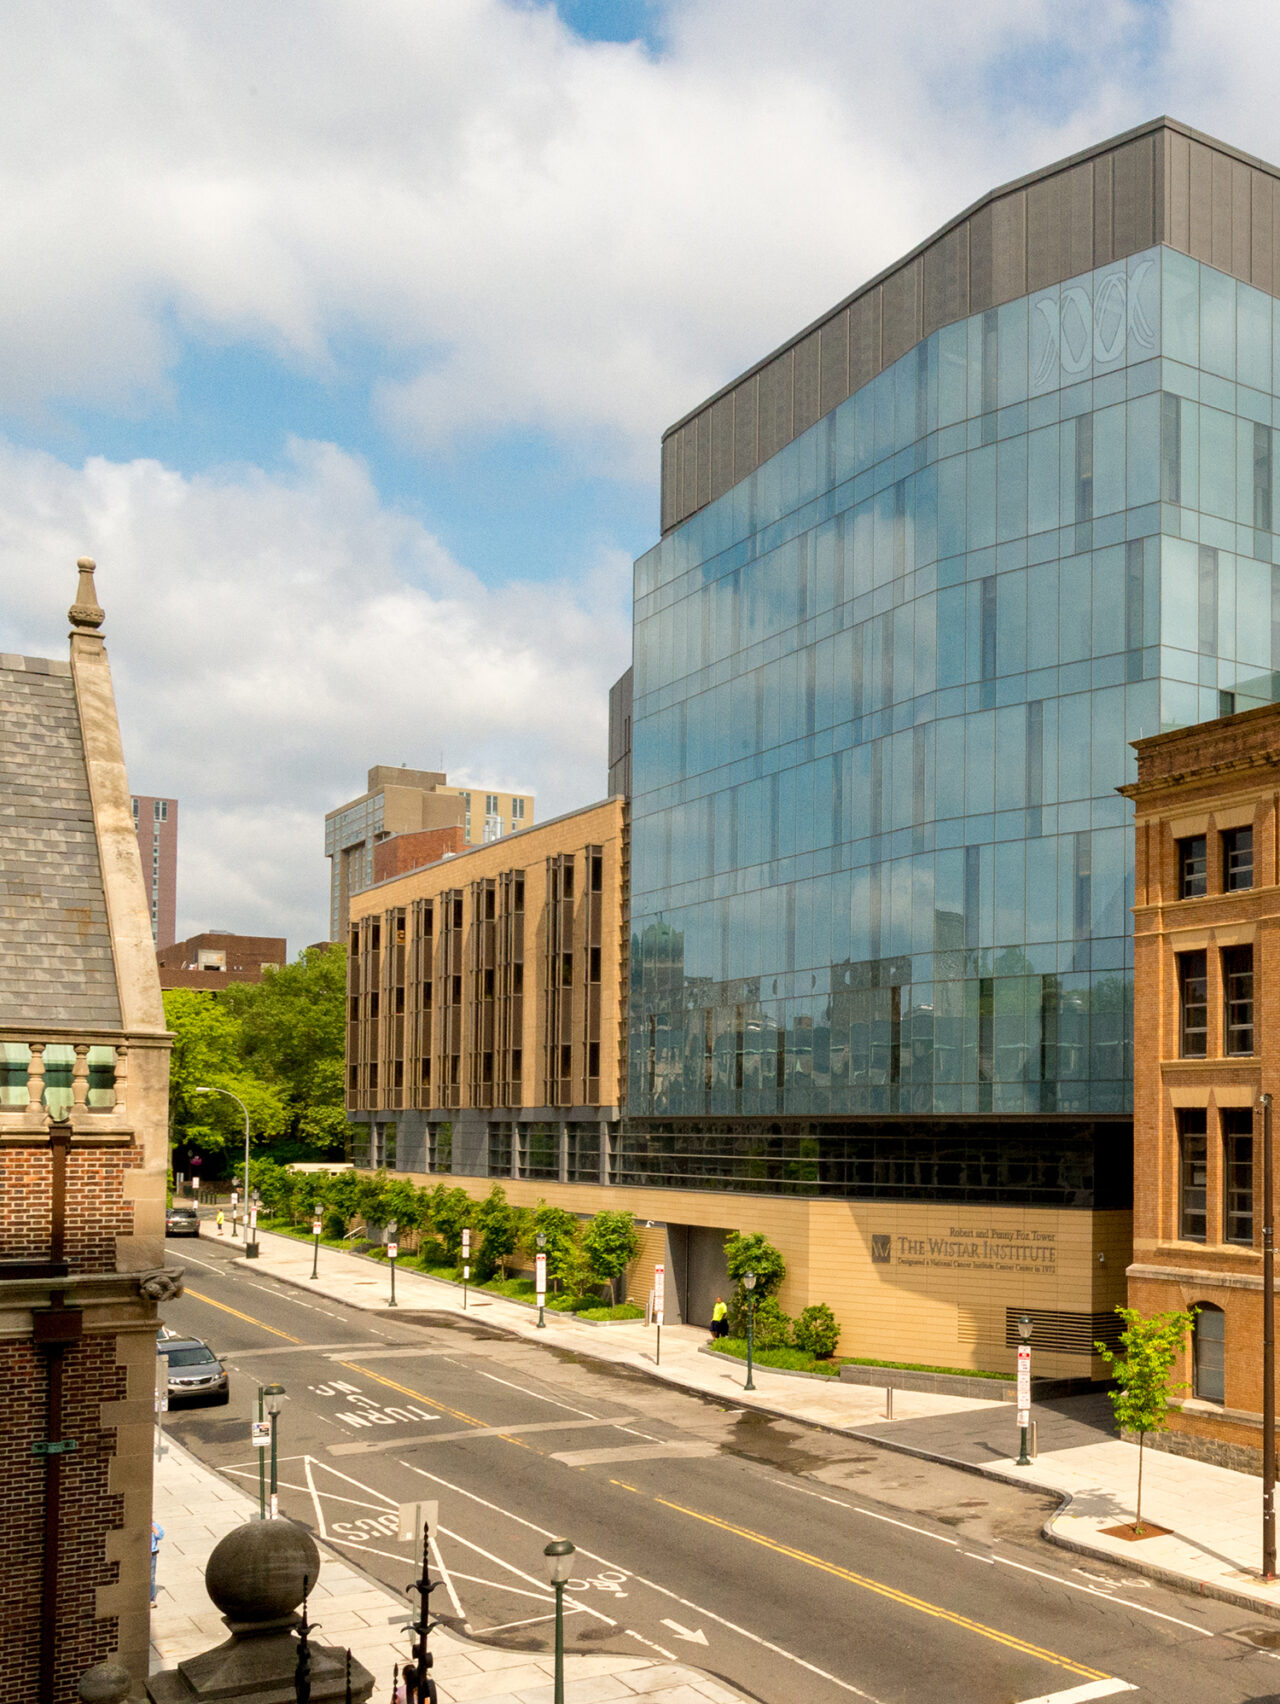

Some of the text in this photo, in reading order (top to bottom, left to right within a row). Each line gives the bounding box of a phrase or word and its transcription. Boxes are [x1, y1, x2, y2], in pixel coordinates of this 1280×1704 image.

[949, 1227, 1055, 1241] Robert and Penny Fox Tower
[897, 1236, 1056, 1262] THE WISTAR INSTITUTE
[334, 1405, 441, 1428] TURN
